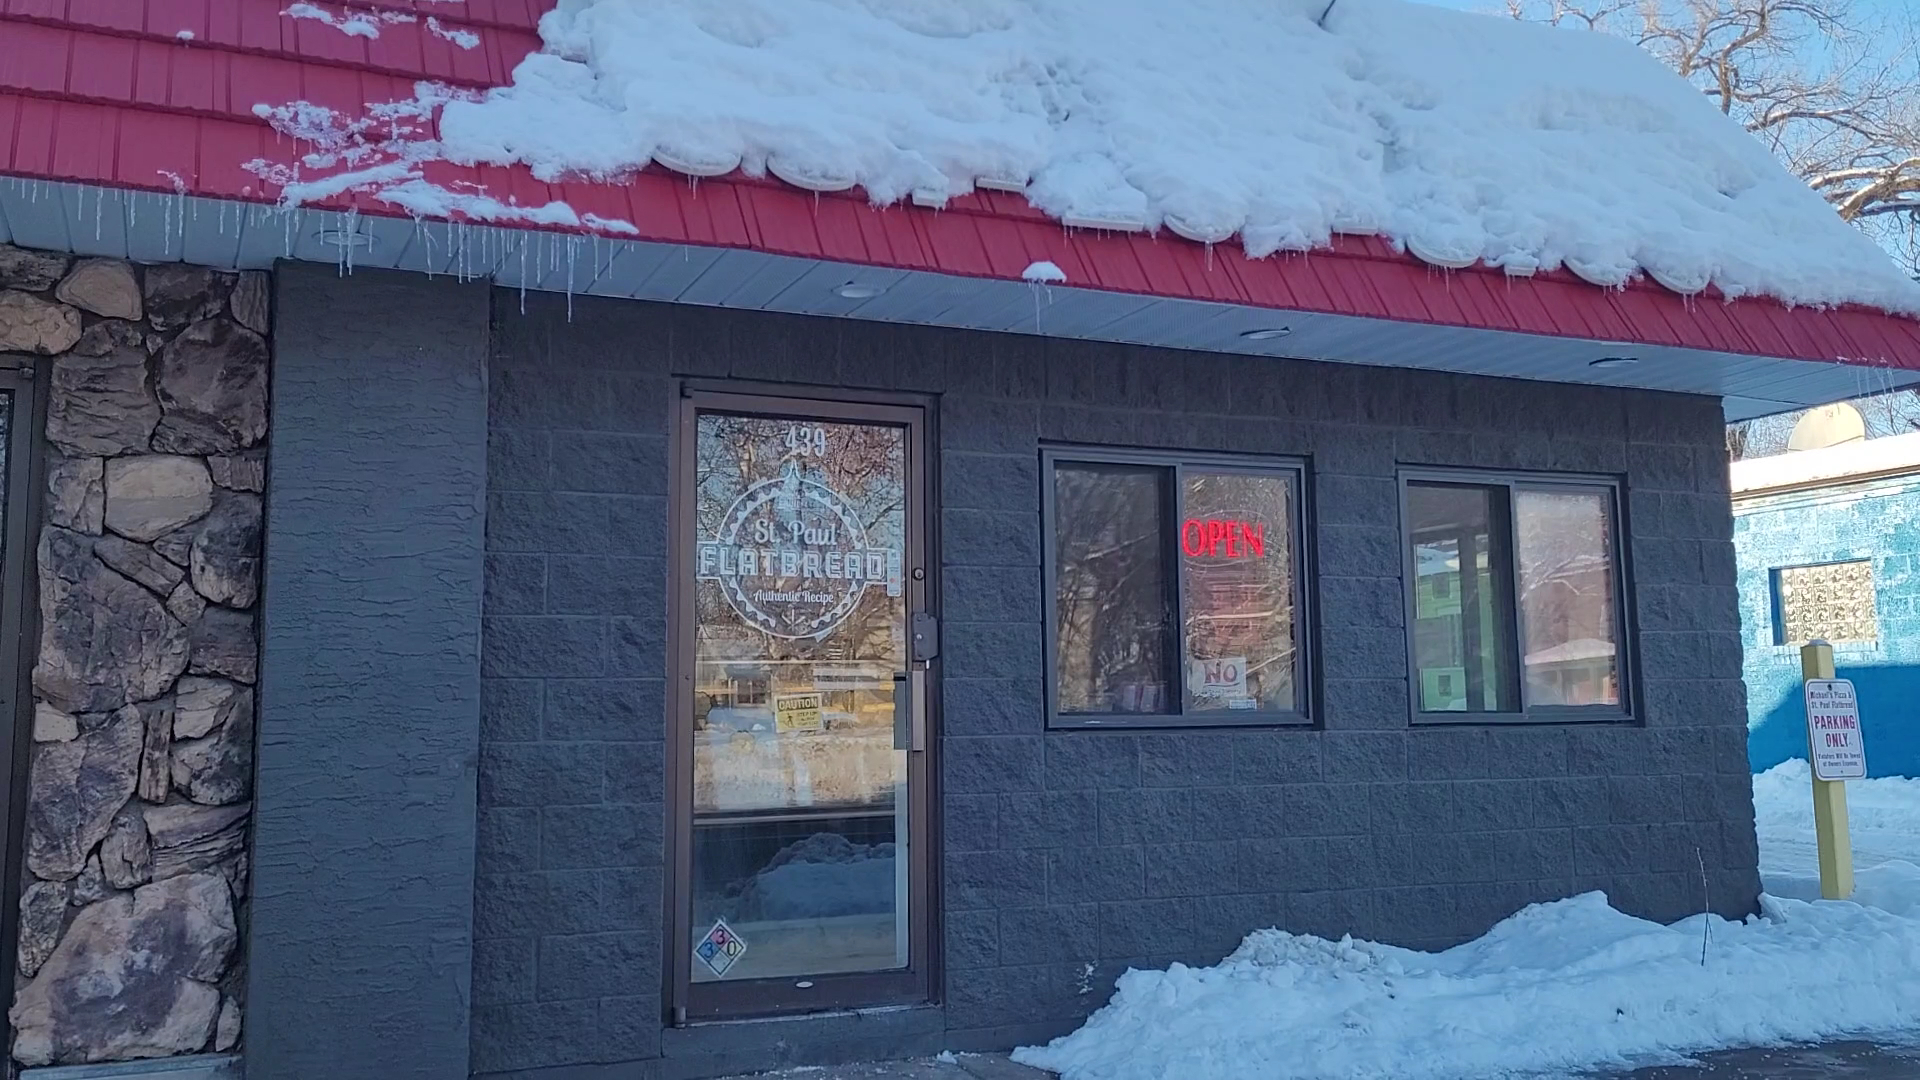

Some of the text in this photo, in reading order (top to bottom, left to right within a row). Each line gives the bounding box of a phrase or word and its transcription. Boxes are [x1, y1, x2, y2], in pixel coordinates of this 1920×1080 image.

[785, 425, 826, 457] 439
[755, 519, 837, 546] St. Paul
[1181, 519, 1264, 558] OPEN
[700, 546, 885, 580] FLATBREAD
[753, 589, 834, 604] Authentic Recipe
[1203, 662, 1237, 683] NO
[778, 697, 818, 710] CAUTION
[1834, 691, 1847, 699] Pizza
[1813, 715, 1856, 730] PARKING
[1825, 733, 1849, 748] ONLY
[715, 929, 726, 945] 3
[704, 941, 714, 958] 3
[727, 940, 736, 957] 0
